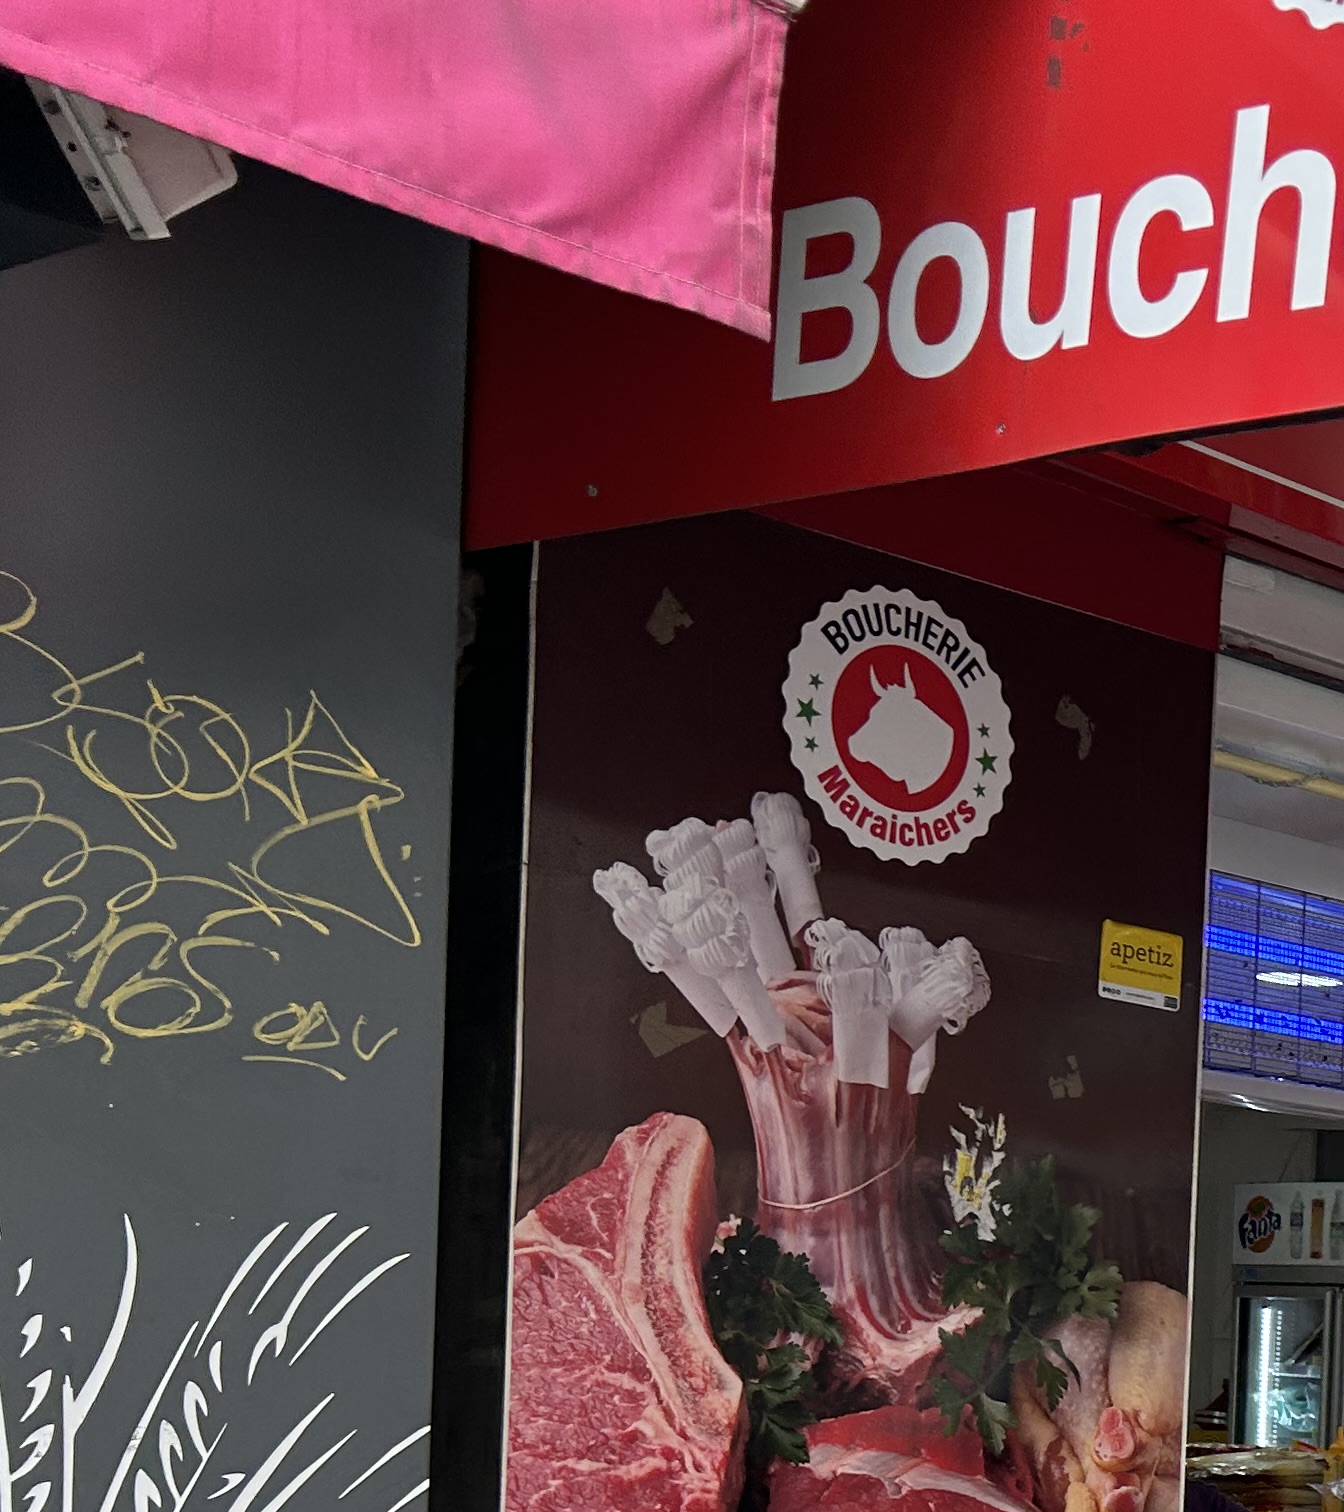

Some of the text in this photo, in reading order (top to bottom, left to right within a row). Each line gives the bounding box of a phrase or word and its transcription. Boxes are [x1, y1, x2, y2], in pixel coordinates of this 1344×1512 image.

[821, 602, 987, 688] BOUCHERIE
[817, 764, 977, 848] Maraichers
[1110, 941, 1174, 968] apetiz
[1238, 1209, 1282, 1250] Fanta
